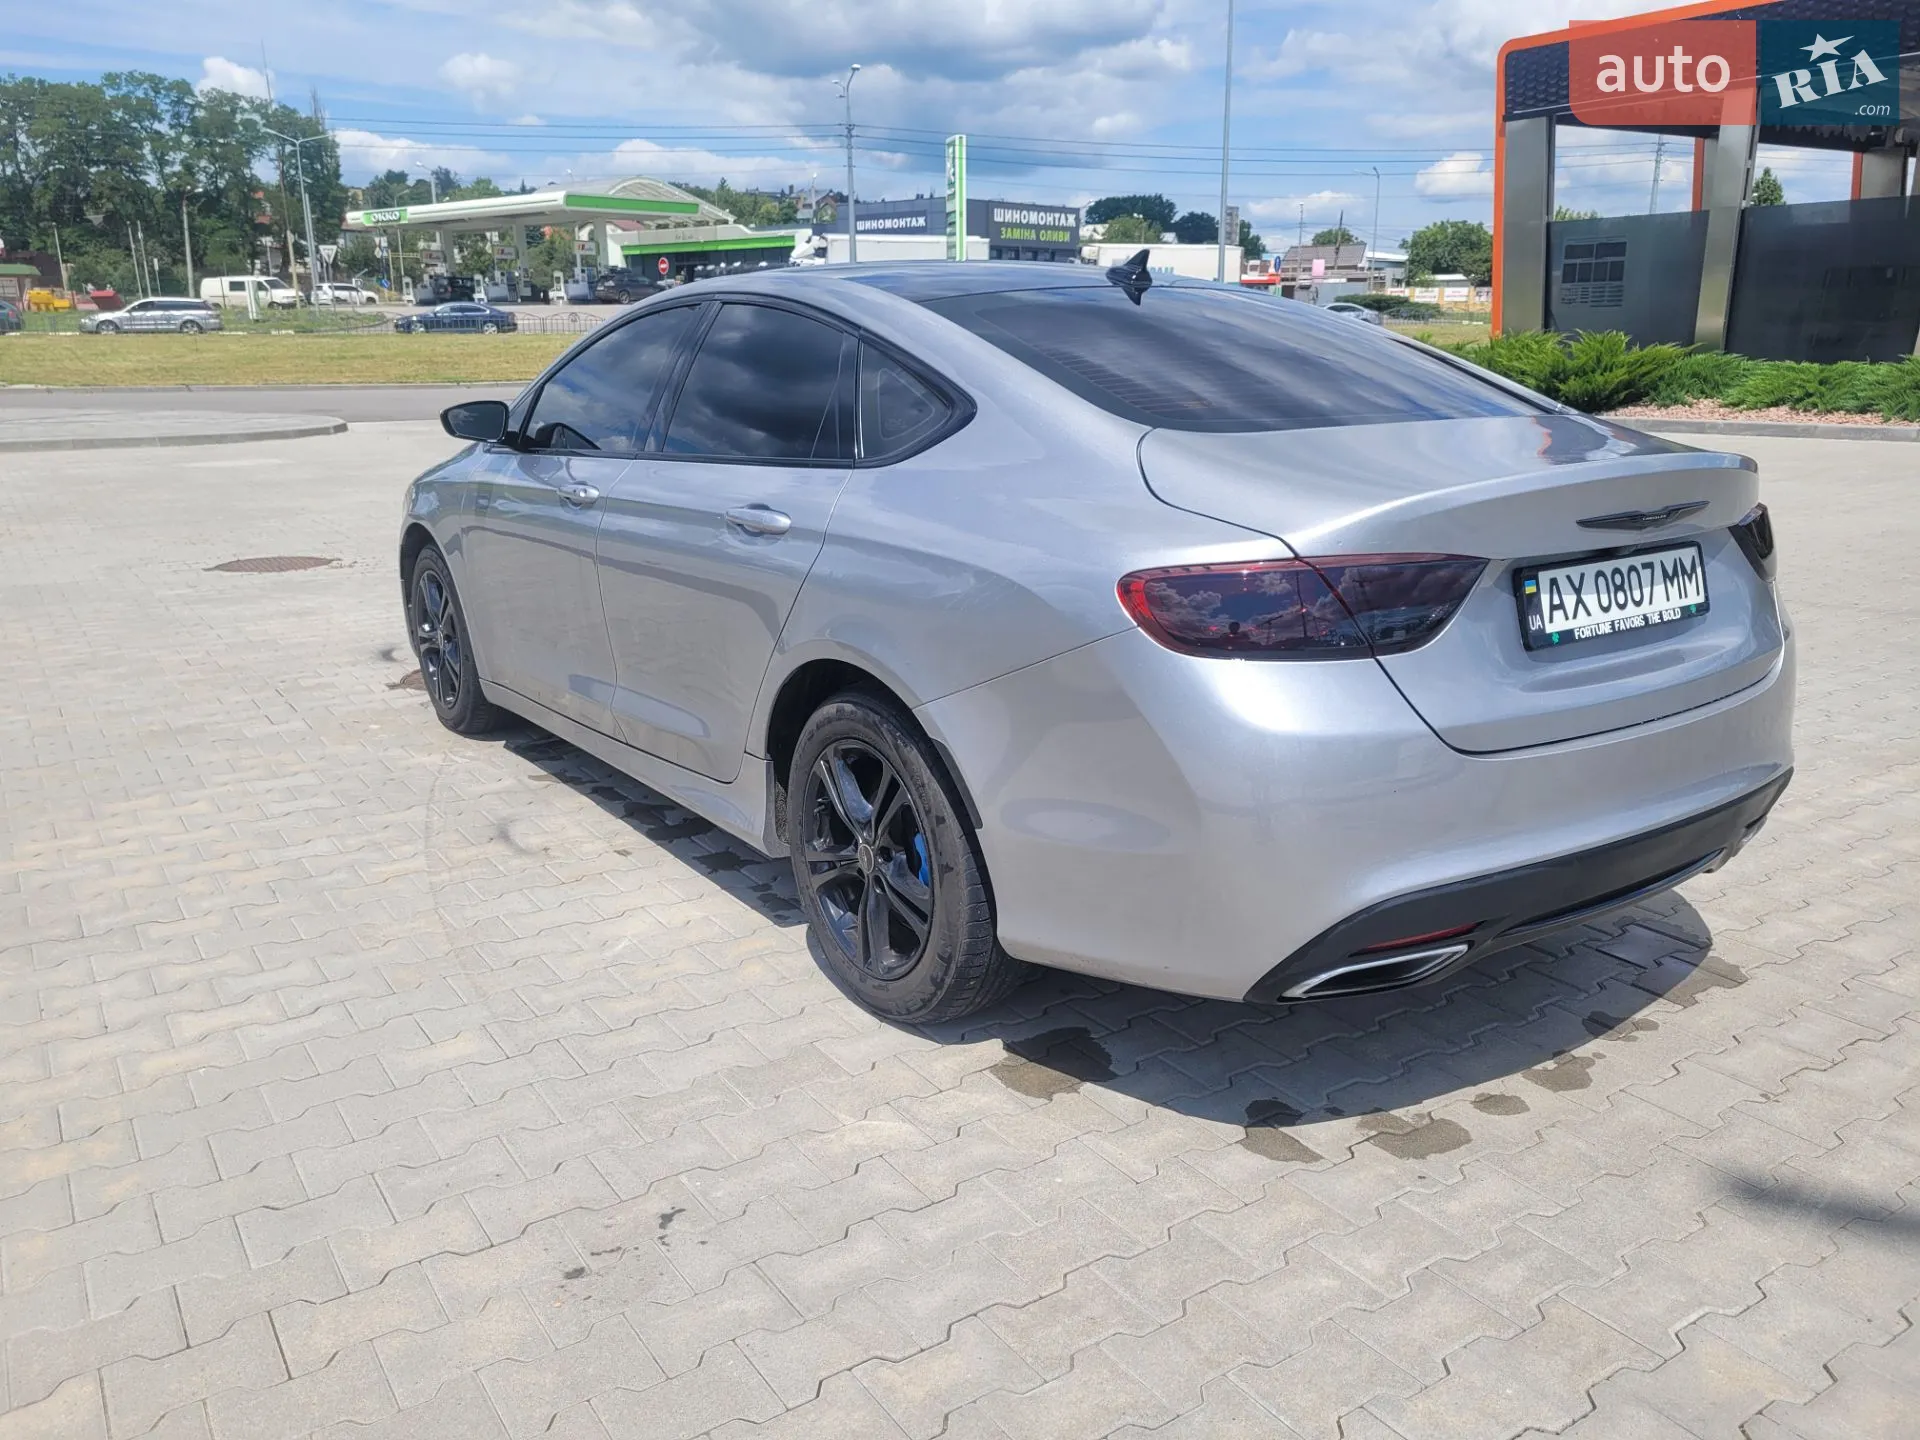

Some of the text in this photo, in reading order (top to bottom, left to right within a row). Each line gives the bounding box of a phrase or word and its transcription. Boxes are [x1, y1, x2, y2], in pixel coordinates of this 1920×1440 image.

[856, 216, 926, 231] ШИНОМОНТАЖ
[994, 208, 1076, 228] ШИНОМОНТАЖ
[1000, 227, 1036, 241] ЗАМІНА
[1040, 229, 1070, 243] ОЛИВИ
[1529, 614, 1543, 631] UA
[1574, 608, 1681, 640] FORTUNE FAVORS THE BOLD
